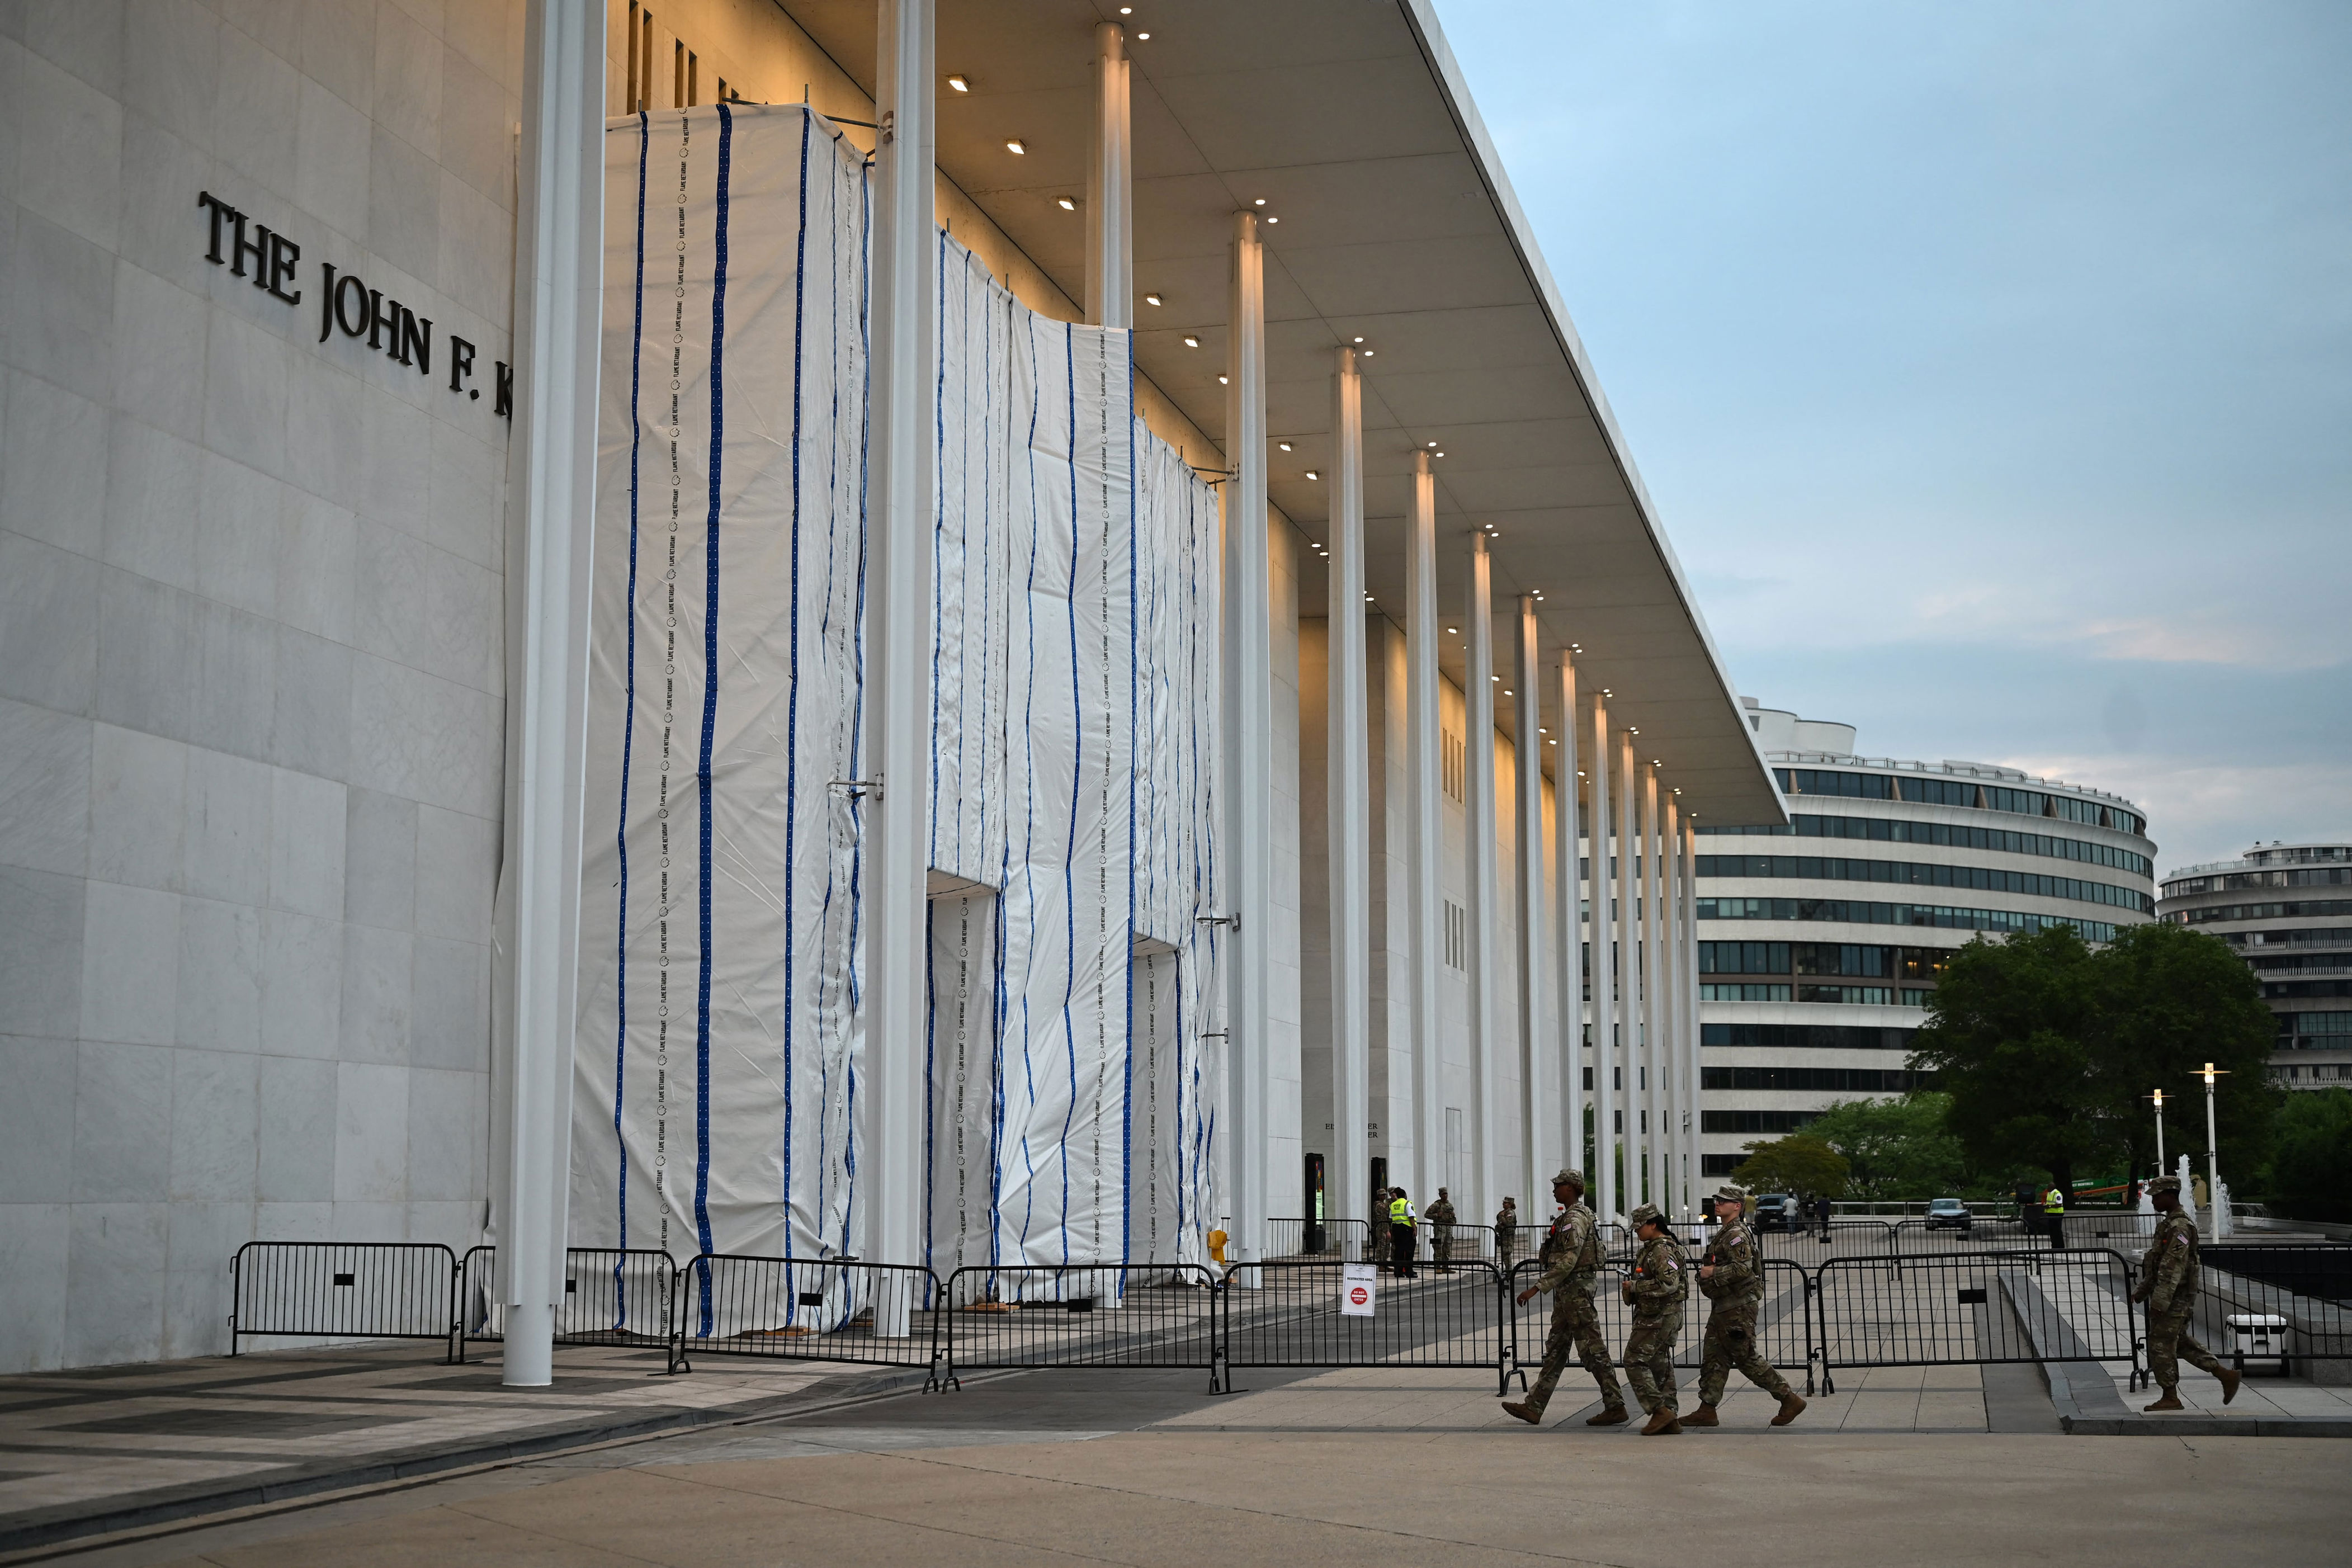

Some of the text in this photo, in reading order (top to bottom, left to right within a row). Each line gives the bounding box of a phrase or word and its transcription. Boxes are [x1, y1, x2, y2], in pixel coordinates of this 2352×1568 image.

[198, 191, 301, 305] THE
[319, 262, 433, 375] JOHN
[449, 336, 480, 401] F.
